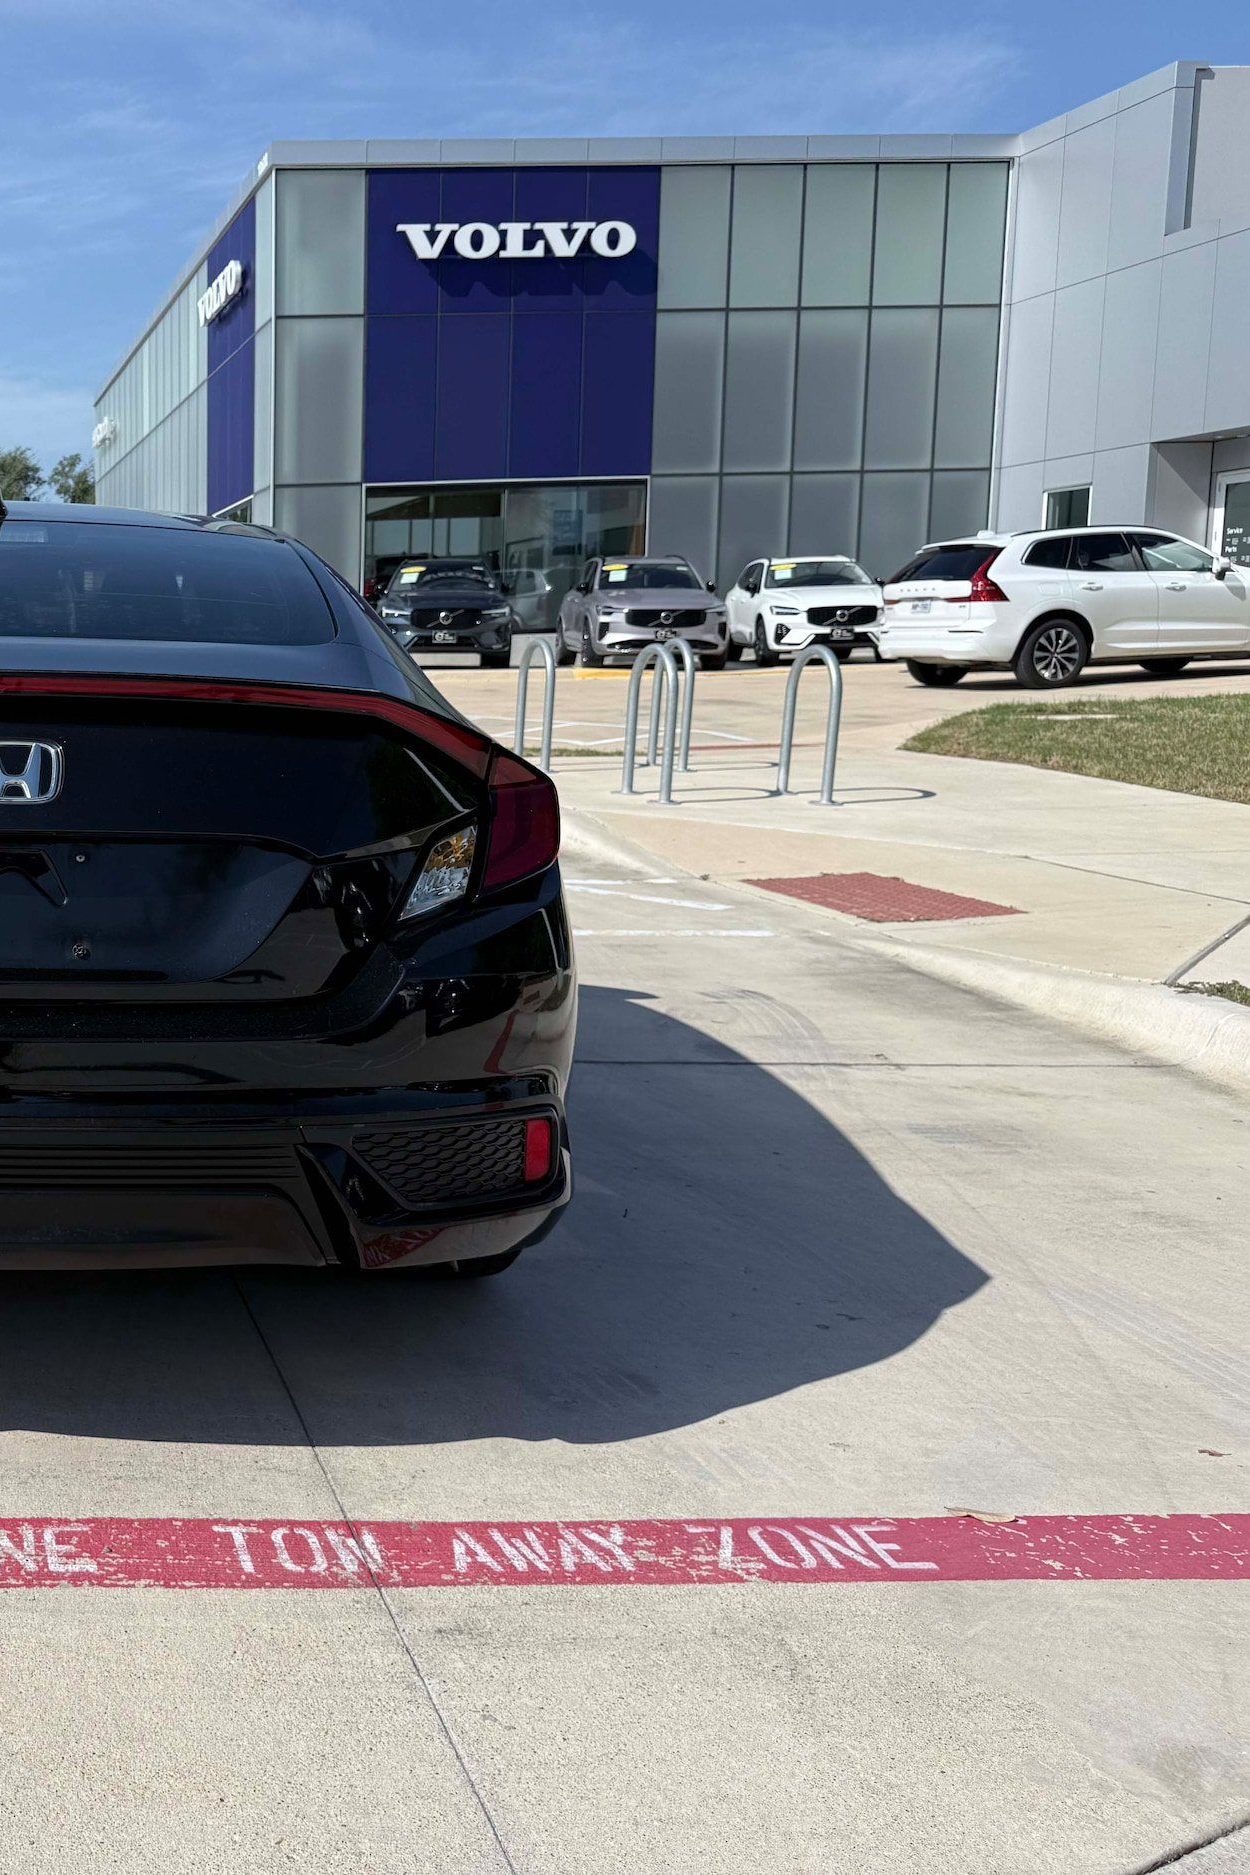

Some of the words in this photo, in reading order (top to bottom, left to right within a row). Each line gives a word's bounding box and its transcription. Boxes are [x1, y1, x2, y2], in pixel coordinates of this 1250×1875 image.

[396, 220, 637, 260] VOLVO
[197, 259, 242, 327] VOLVO
[211, 1524, 385, 1576] TOW
[450, 1522, 636, 1575] AWAY
[684, 1522, 940, 1573] ZONE
